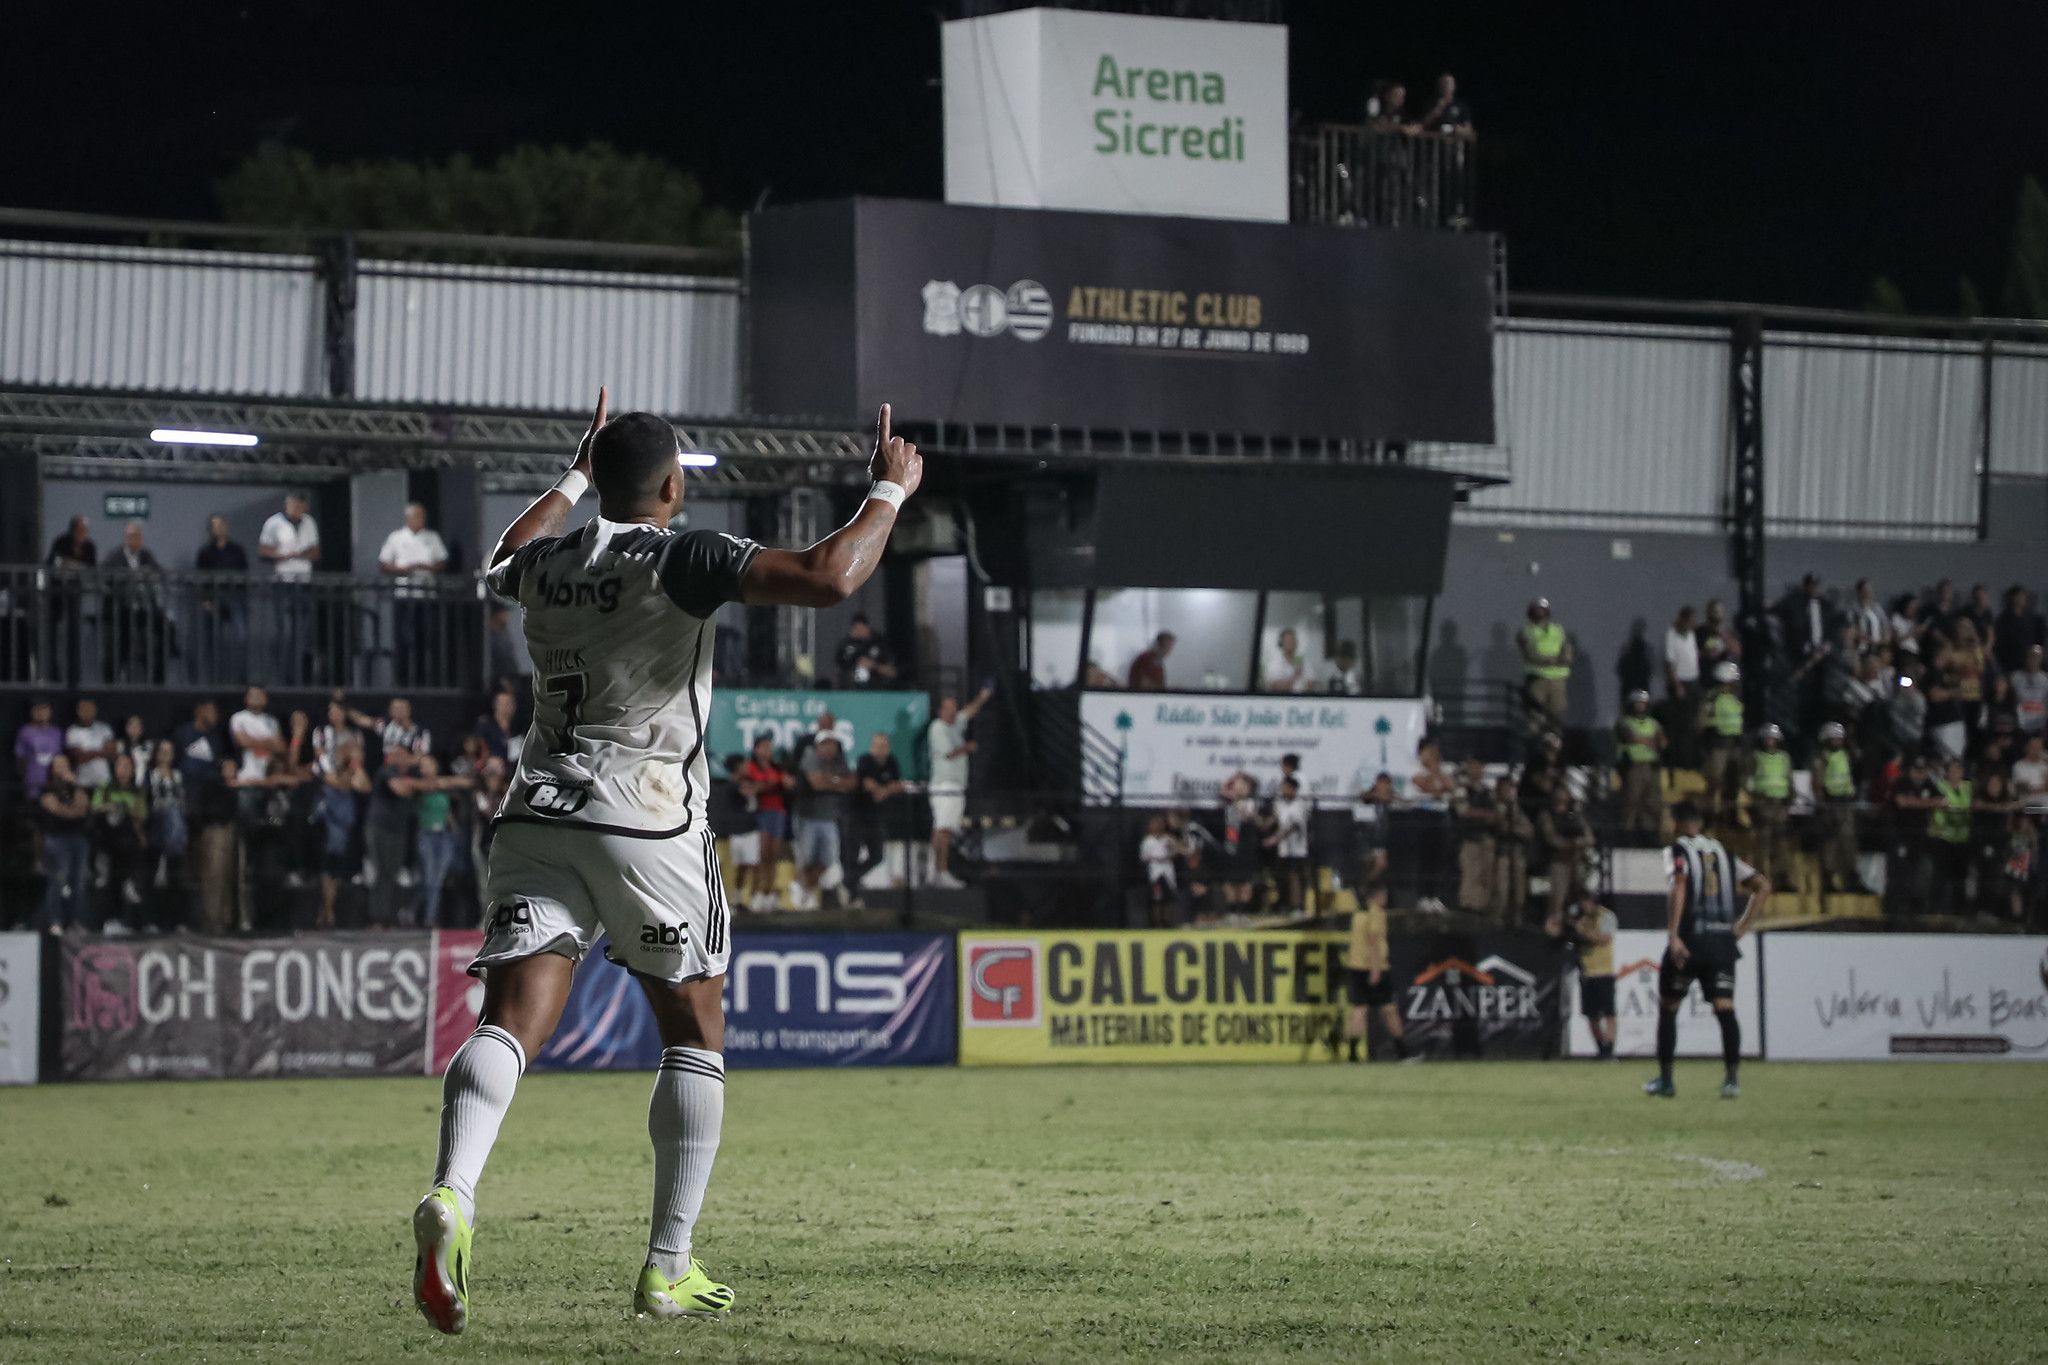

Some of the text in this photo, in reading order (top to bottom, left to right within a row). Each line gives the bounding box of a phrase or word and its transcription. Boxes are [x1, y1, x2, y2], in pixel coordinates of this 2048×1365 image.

[1094, 53, 1225, 105] Arena
[1094, 111, 1246, 161] Sicredi
[1067, 286, 1262, 328] ATHLETIC CLUB
[1181, 328, 1202, 349] DE
[1252, 331, 1271, 352] DE
[545, 647, 585, 672] HULK
[545, 672, 589, 756] 7
[1156, 702, 1205, 724] Rádio
[1211, 704, 1241, 725] São
[1245, 705, 1282, 731] João
[530, 784, 584, 812] BH
[494, 901, 529, 927] bc
[640, 921, 688, 945] abc
[138, 950, 426, 1024] CH FONES
[764, 1031, 778, 1049] e
[780, 1027, 891, 1052] transportes
[1051, 1013, 1174, 1048] MATERIAIS
[1182, 1013, 1209, 1047] DE
